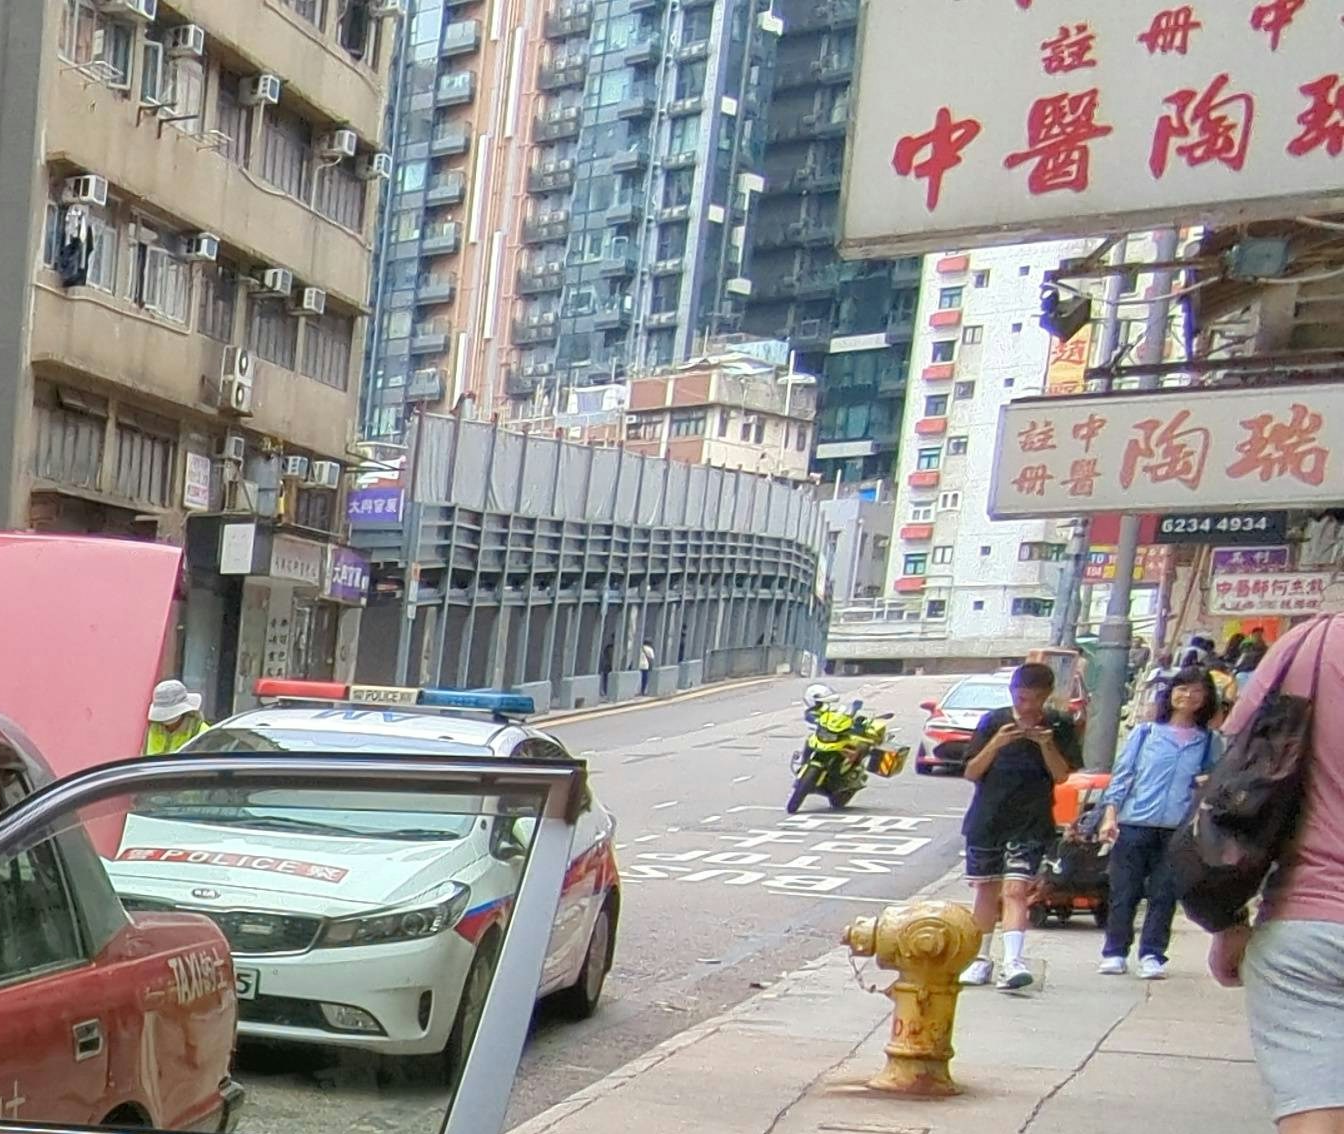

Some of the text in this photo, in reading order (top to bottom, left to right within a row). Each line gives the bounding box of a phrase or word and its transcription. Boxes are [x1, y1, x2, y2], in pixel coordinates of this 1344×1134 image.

[1041, 0, 1344, 75] 註冊中
[1161, 516, 1267, 533] 6234 4934
[365, 690, 400, 703] POLICE
[720, 829, 932, 856] 巴士
[160, 850, 300, 873] POLICE
[635, 850, 905, 873] STOP
[618, 865, 850, 891] BUS
